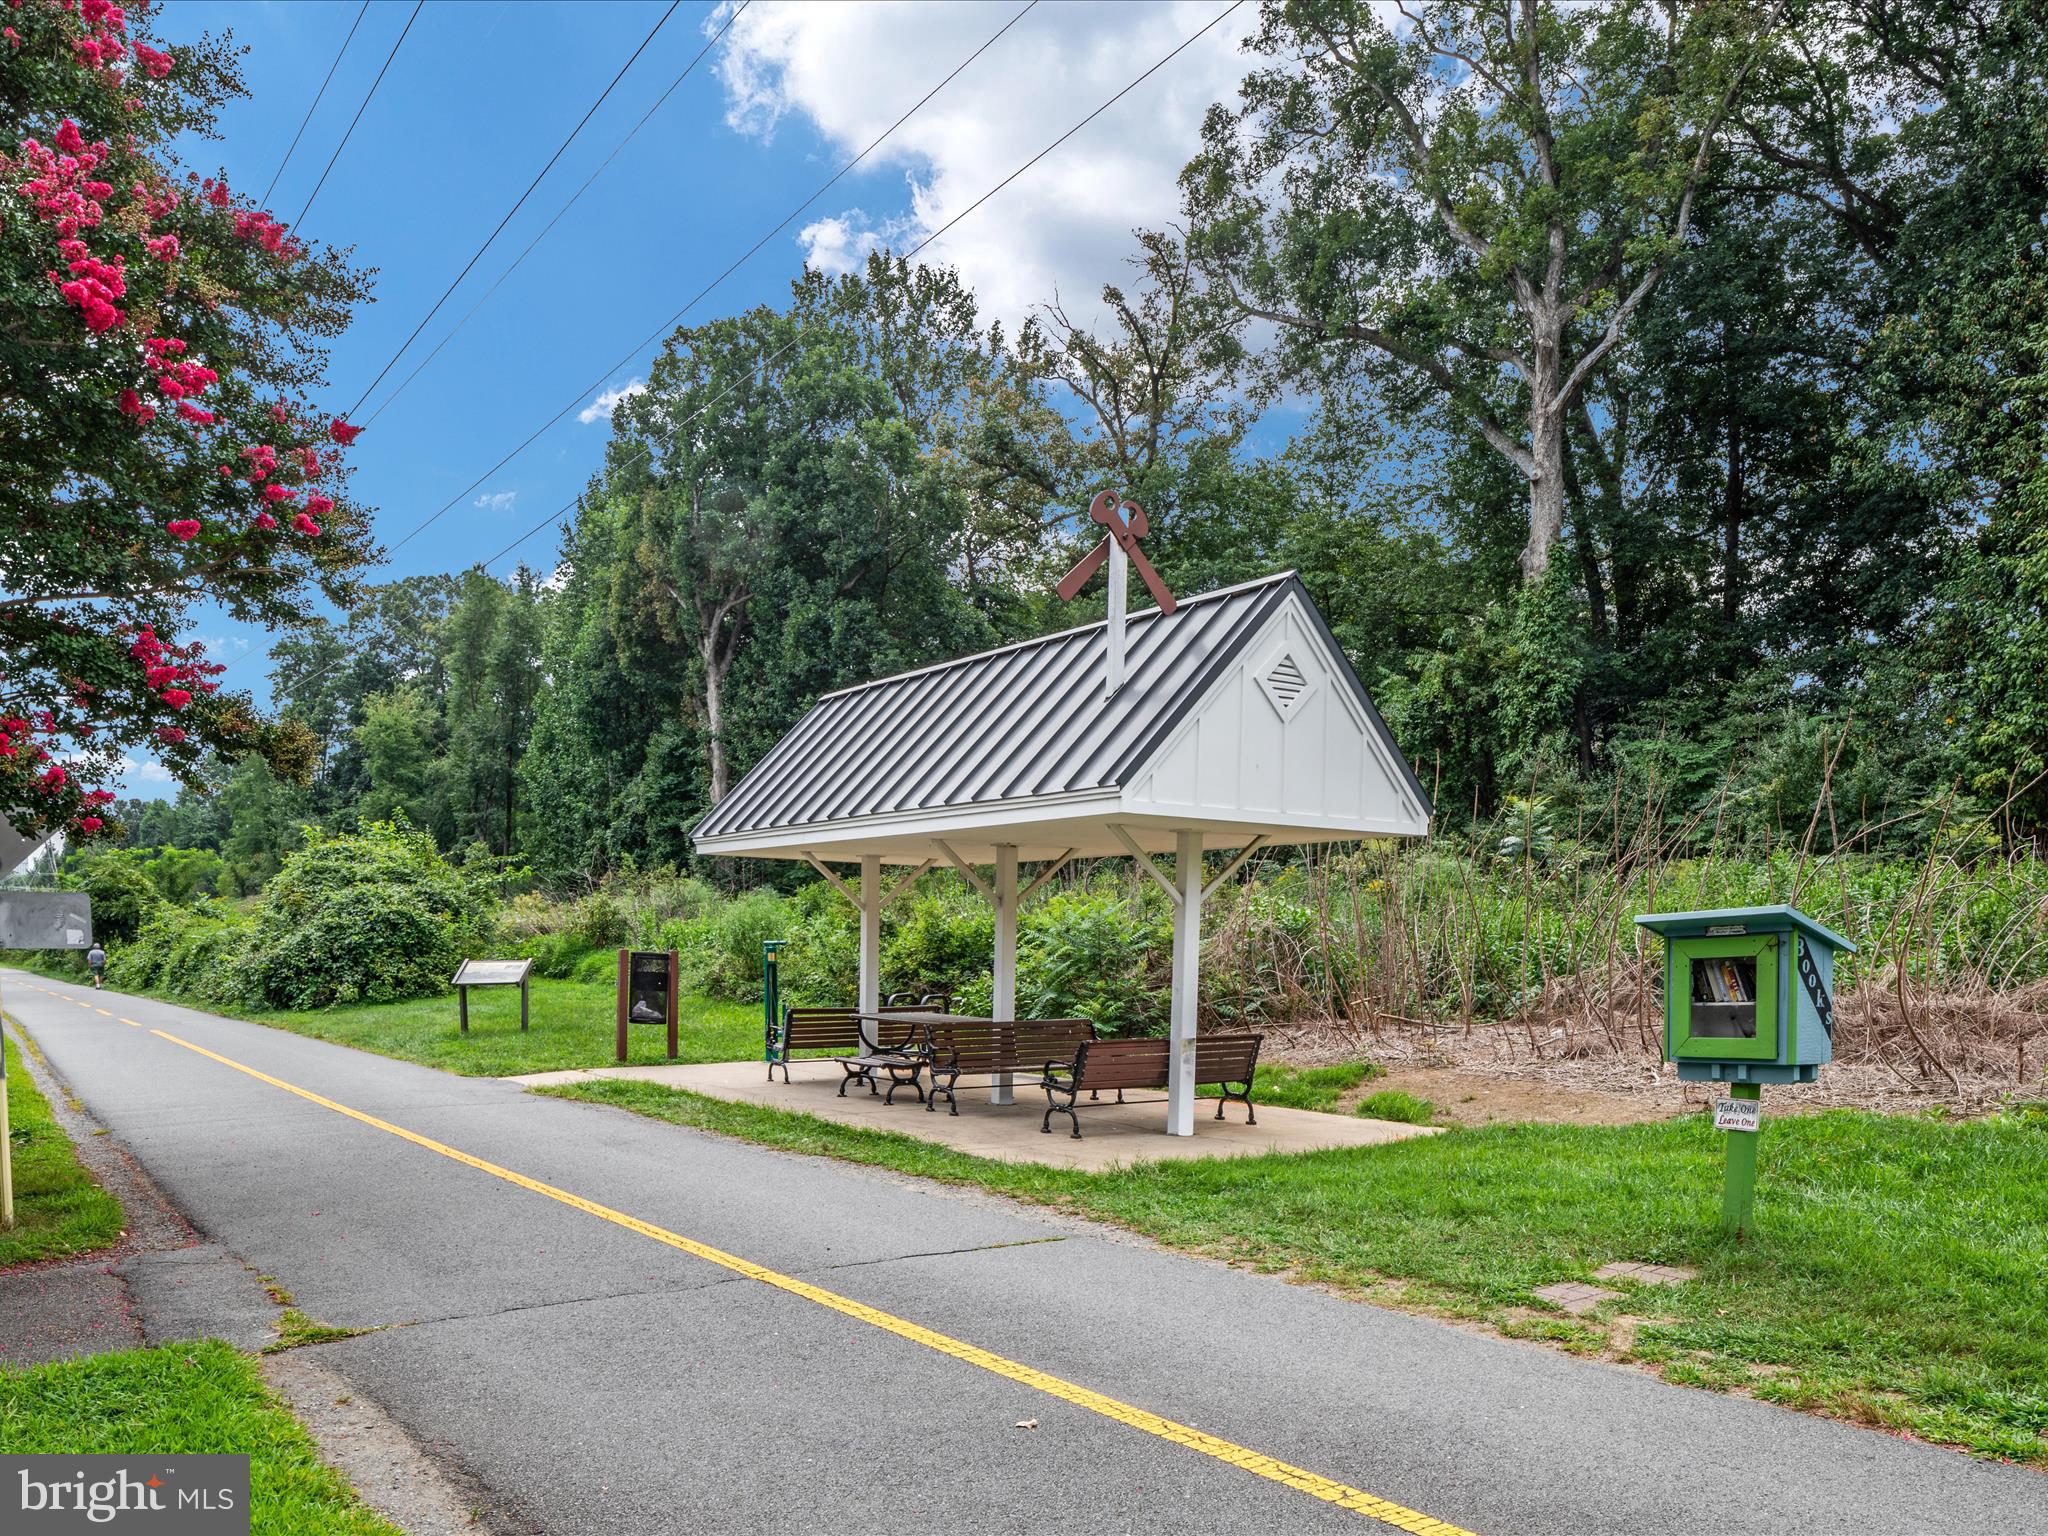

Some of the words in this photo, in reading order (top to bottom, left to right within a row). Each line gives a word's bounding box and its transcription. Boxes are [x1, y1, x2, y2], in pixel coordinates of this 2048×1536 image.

[1718, 1102, 1738, 1113] Take
[1740, 1104, 1756, 1115] One
[1718, 1114, 1740, 1125] Leave
[1741, 1117, 1755, 1127] One
